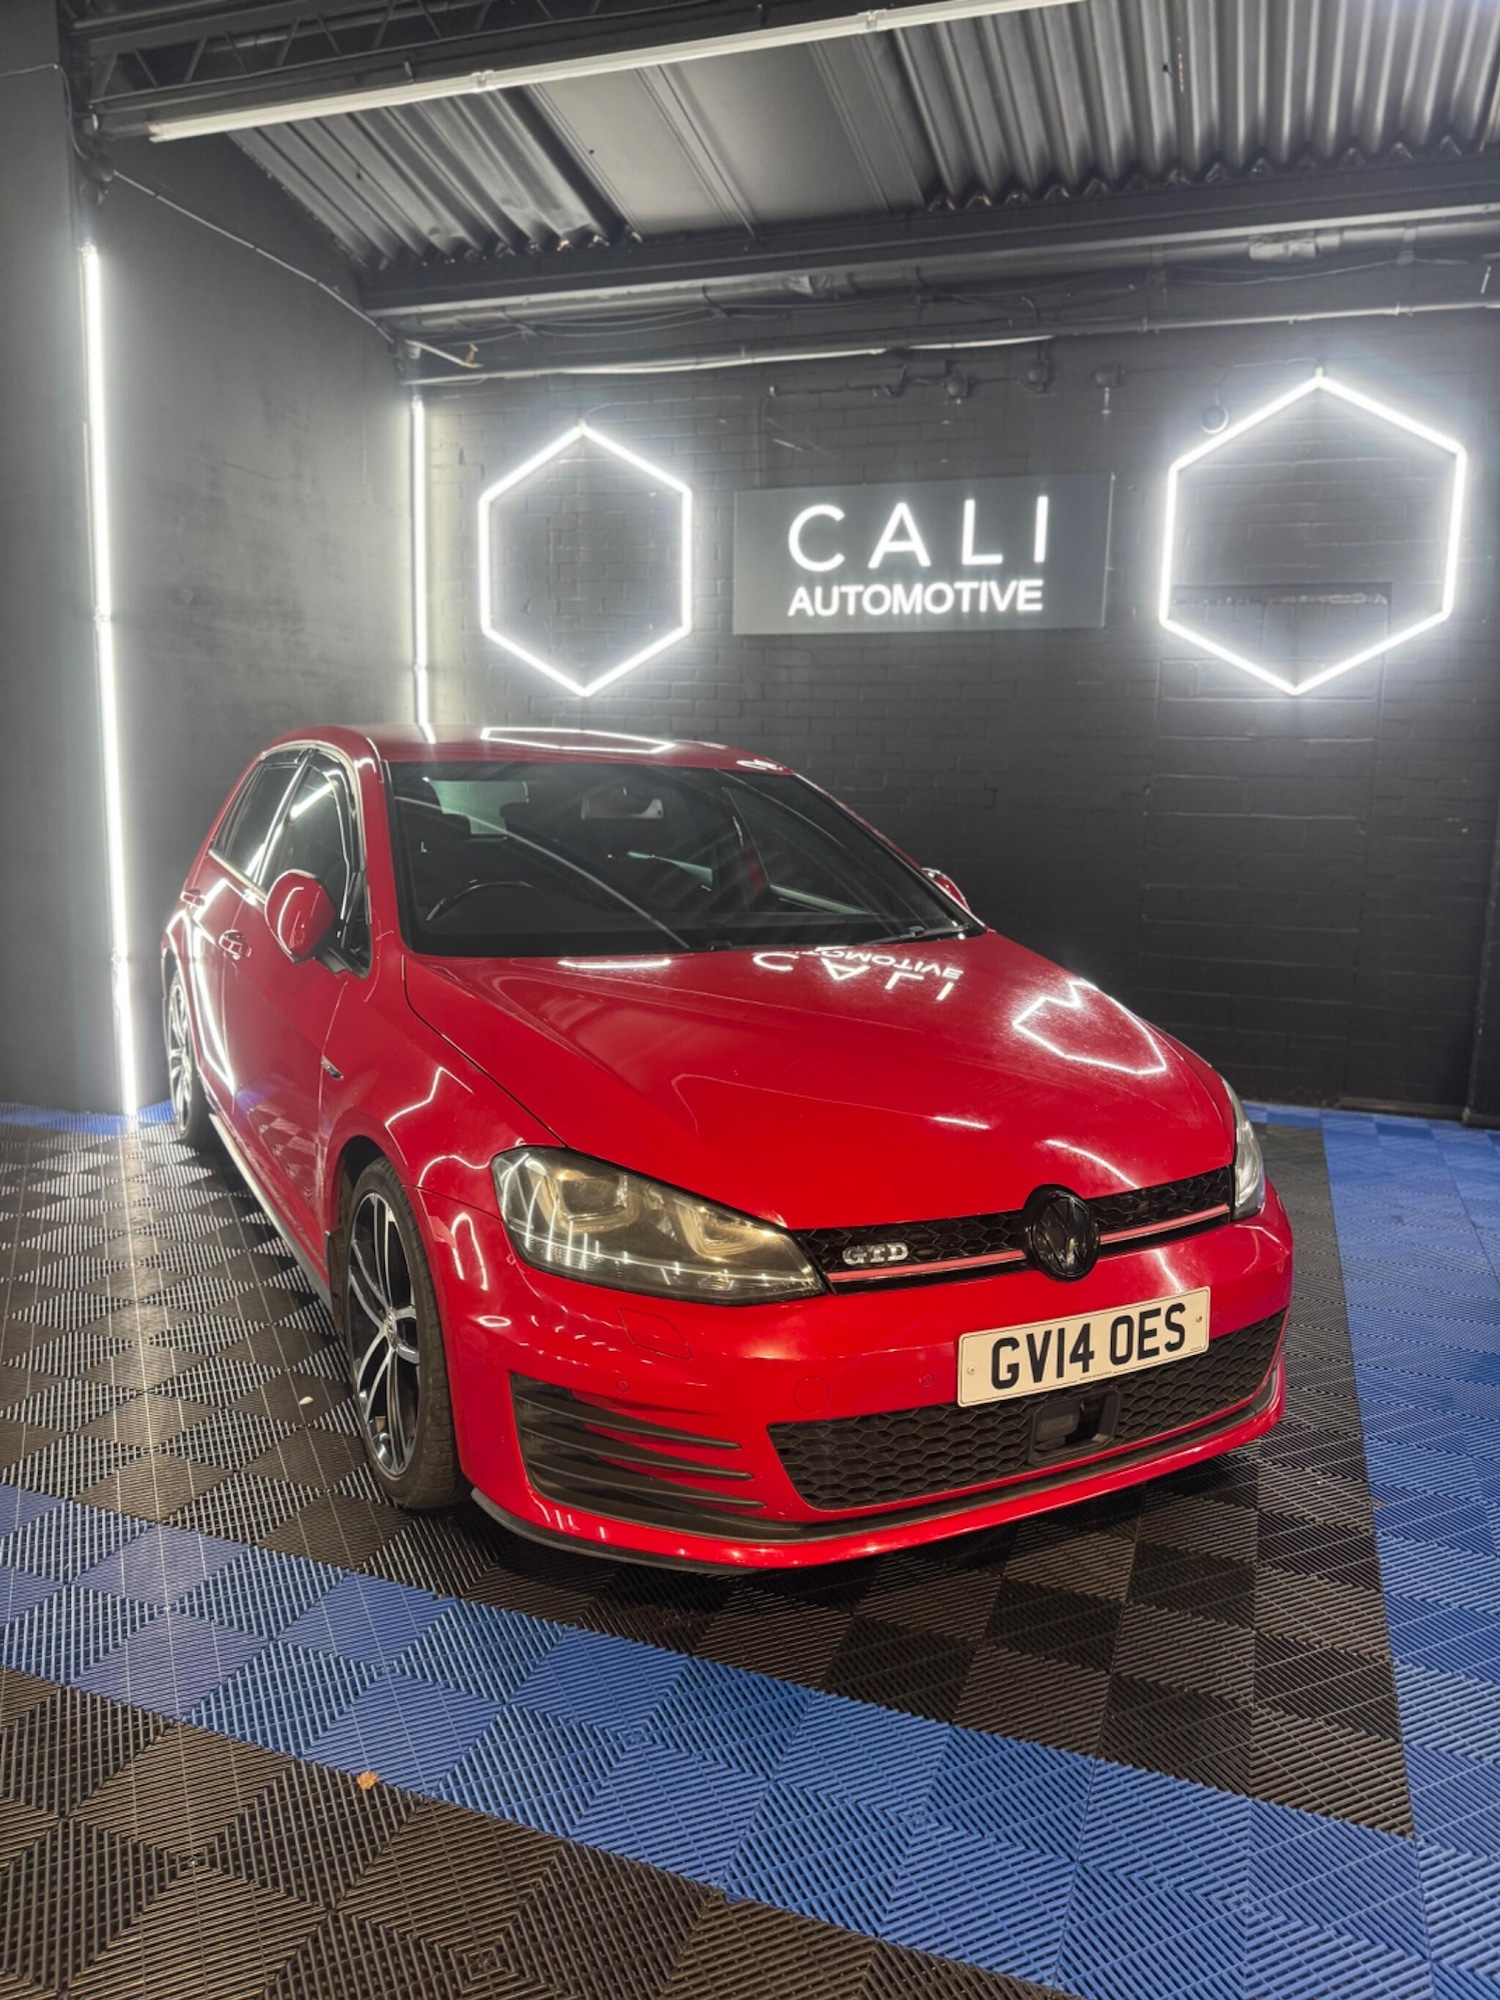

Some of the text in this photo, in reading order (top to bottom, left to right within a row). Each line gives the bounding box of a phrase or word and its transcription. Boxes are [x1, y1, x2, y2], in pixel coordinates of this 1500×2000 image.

[787, 494, 1049, 573] CALI
[787, 578, 1044, 617] AUTOMOTIVE
[842, 1242, 908, 1266] GTD
[991, 1302, 1186, 1390] GV14 OES
